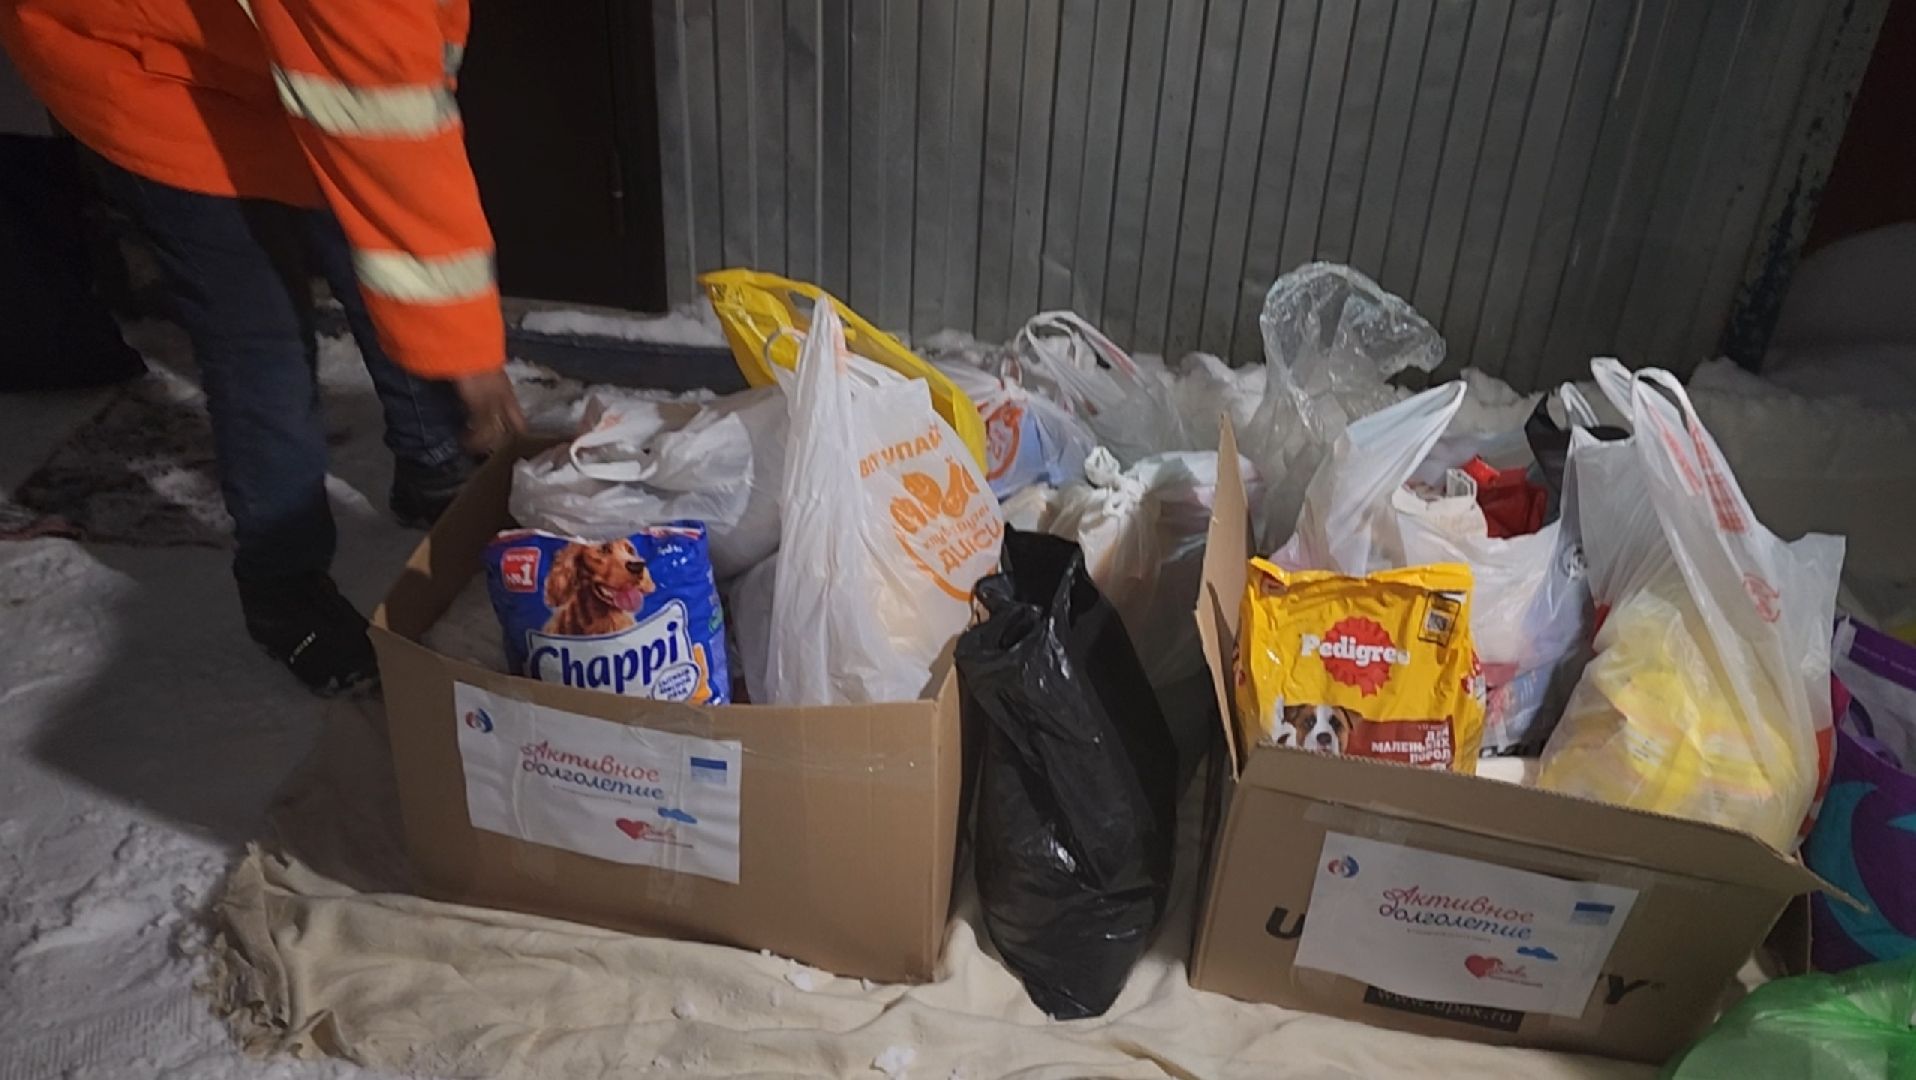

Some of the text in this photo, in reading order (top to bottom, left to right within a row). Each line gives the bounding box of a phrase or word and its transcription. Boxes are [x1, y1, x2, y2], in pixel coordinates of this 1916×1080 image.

[531, 620, 679, 694] Chappi
[520, 740, 662, 783] Активное
[522, 758, 665, 800] долголетие
[1379, 899, 1532, 941] долголетие
[1382, 885, 1535, 924] Активное
